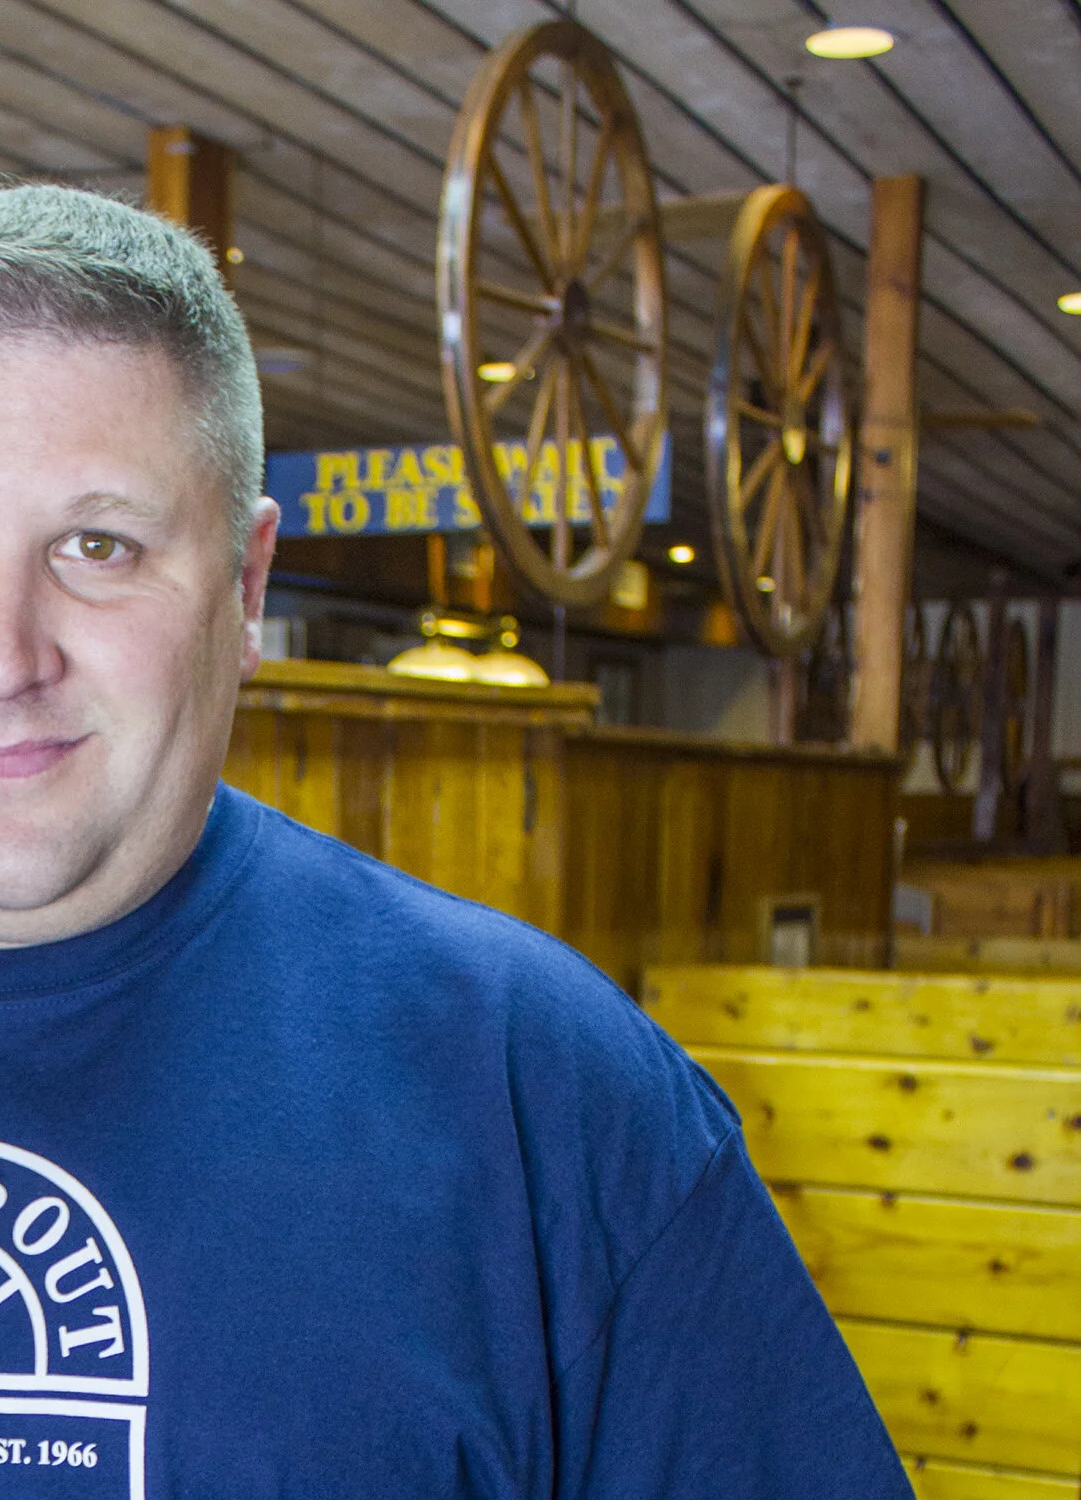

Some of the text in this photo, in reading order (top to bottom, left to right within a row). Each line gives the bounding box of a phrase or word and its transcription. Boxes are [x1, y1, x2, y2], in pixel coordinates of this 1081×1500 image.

[300, 488, 371, 534] TO
[385, 484, 439, 530] BE
[12, 1196, 125, 1359] OUT
[37, 1439, 98, 1468] 1966
